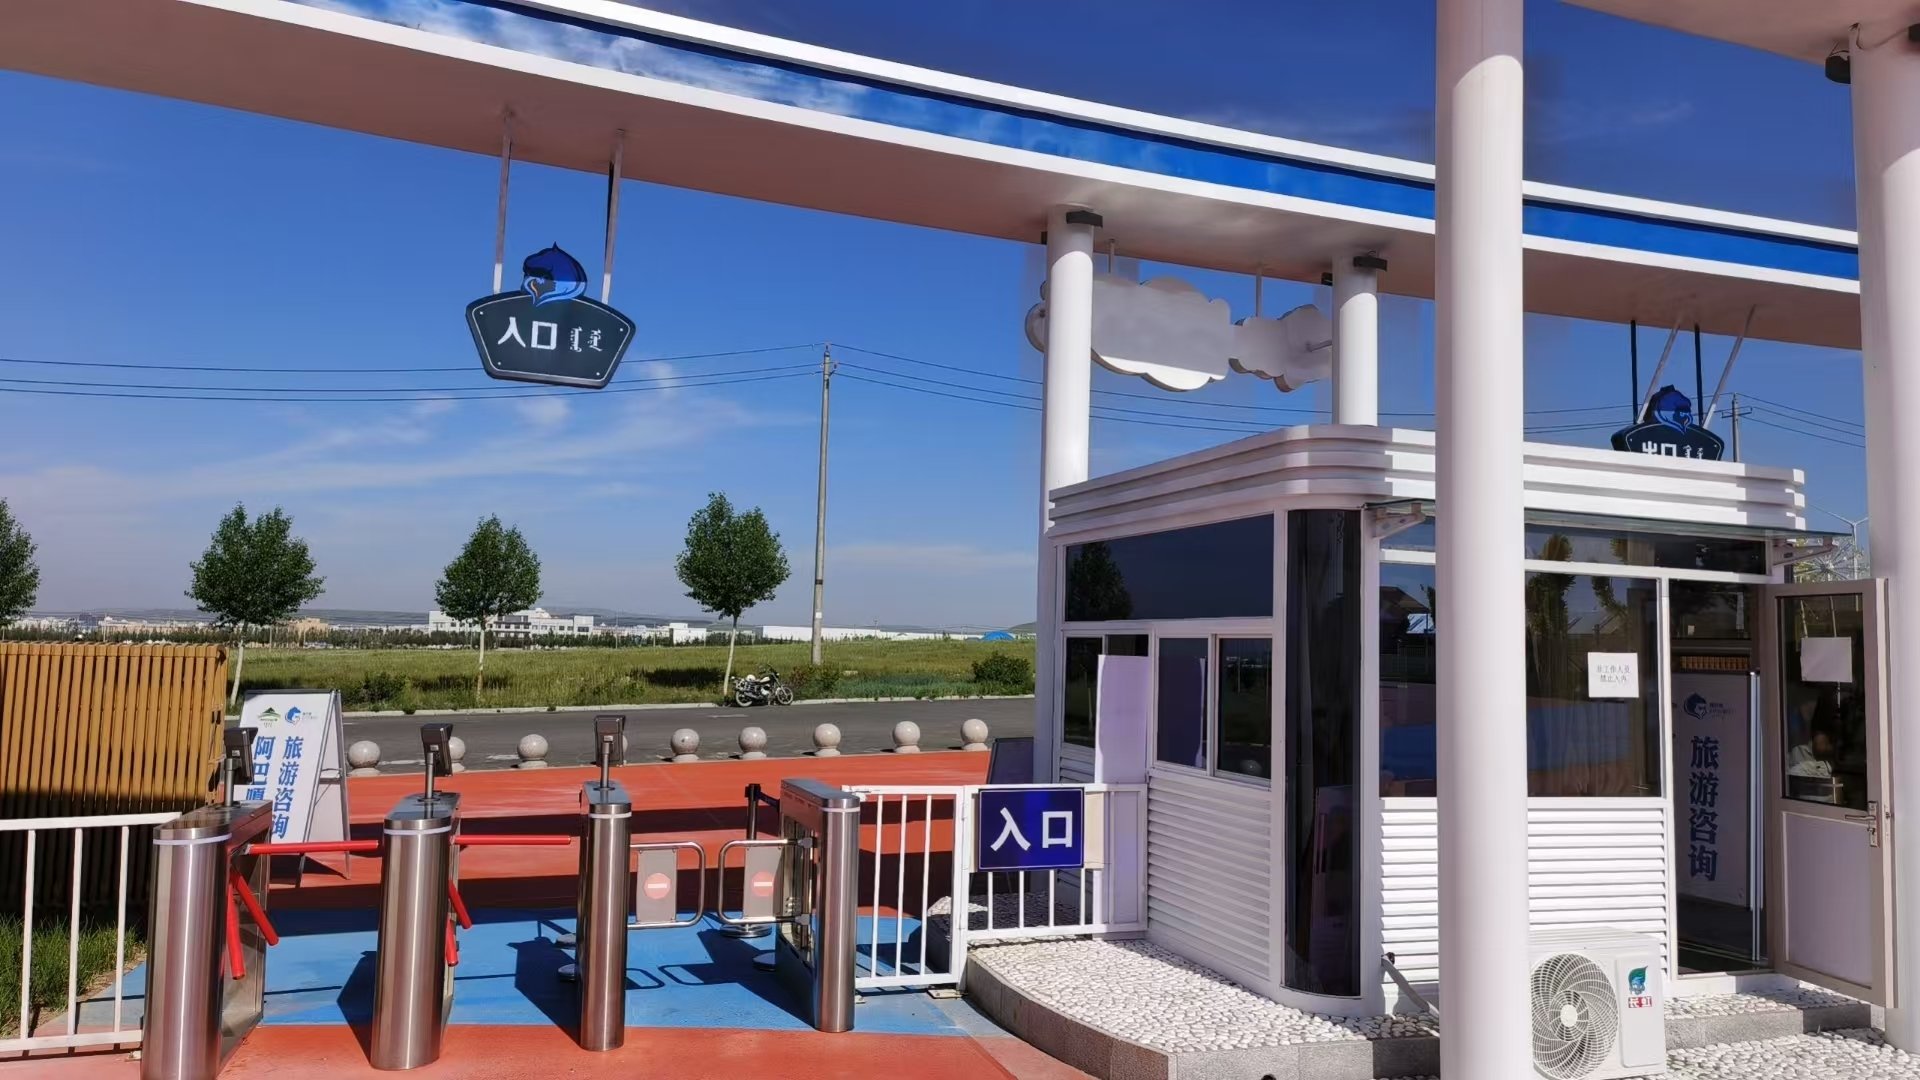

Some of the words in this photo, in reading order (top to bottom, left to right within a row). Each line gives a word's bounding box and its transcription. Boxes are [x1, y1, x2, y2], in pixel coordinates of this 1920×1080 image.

[271, 735, 304, 839] 旅游咨询
[990, 807, 1073, 851] 入口
[1687, 735, 1720, 881] 旅游咨询
